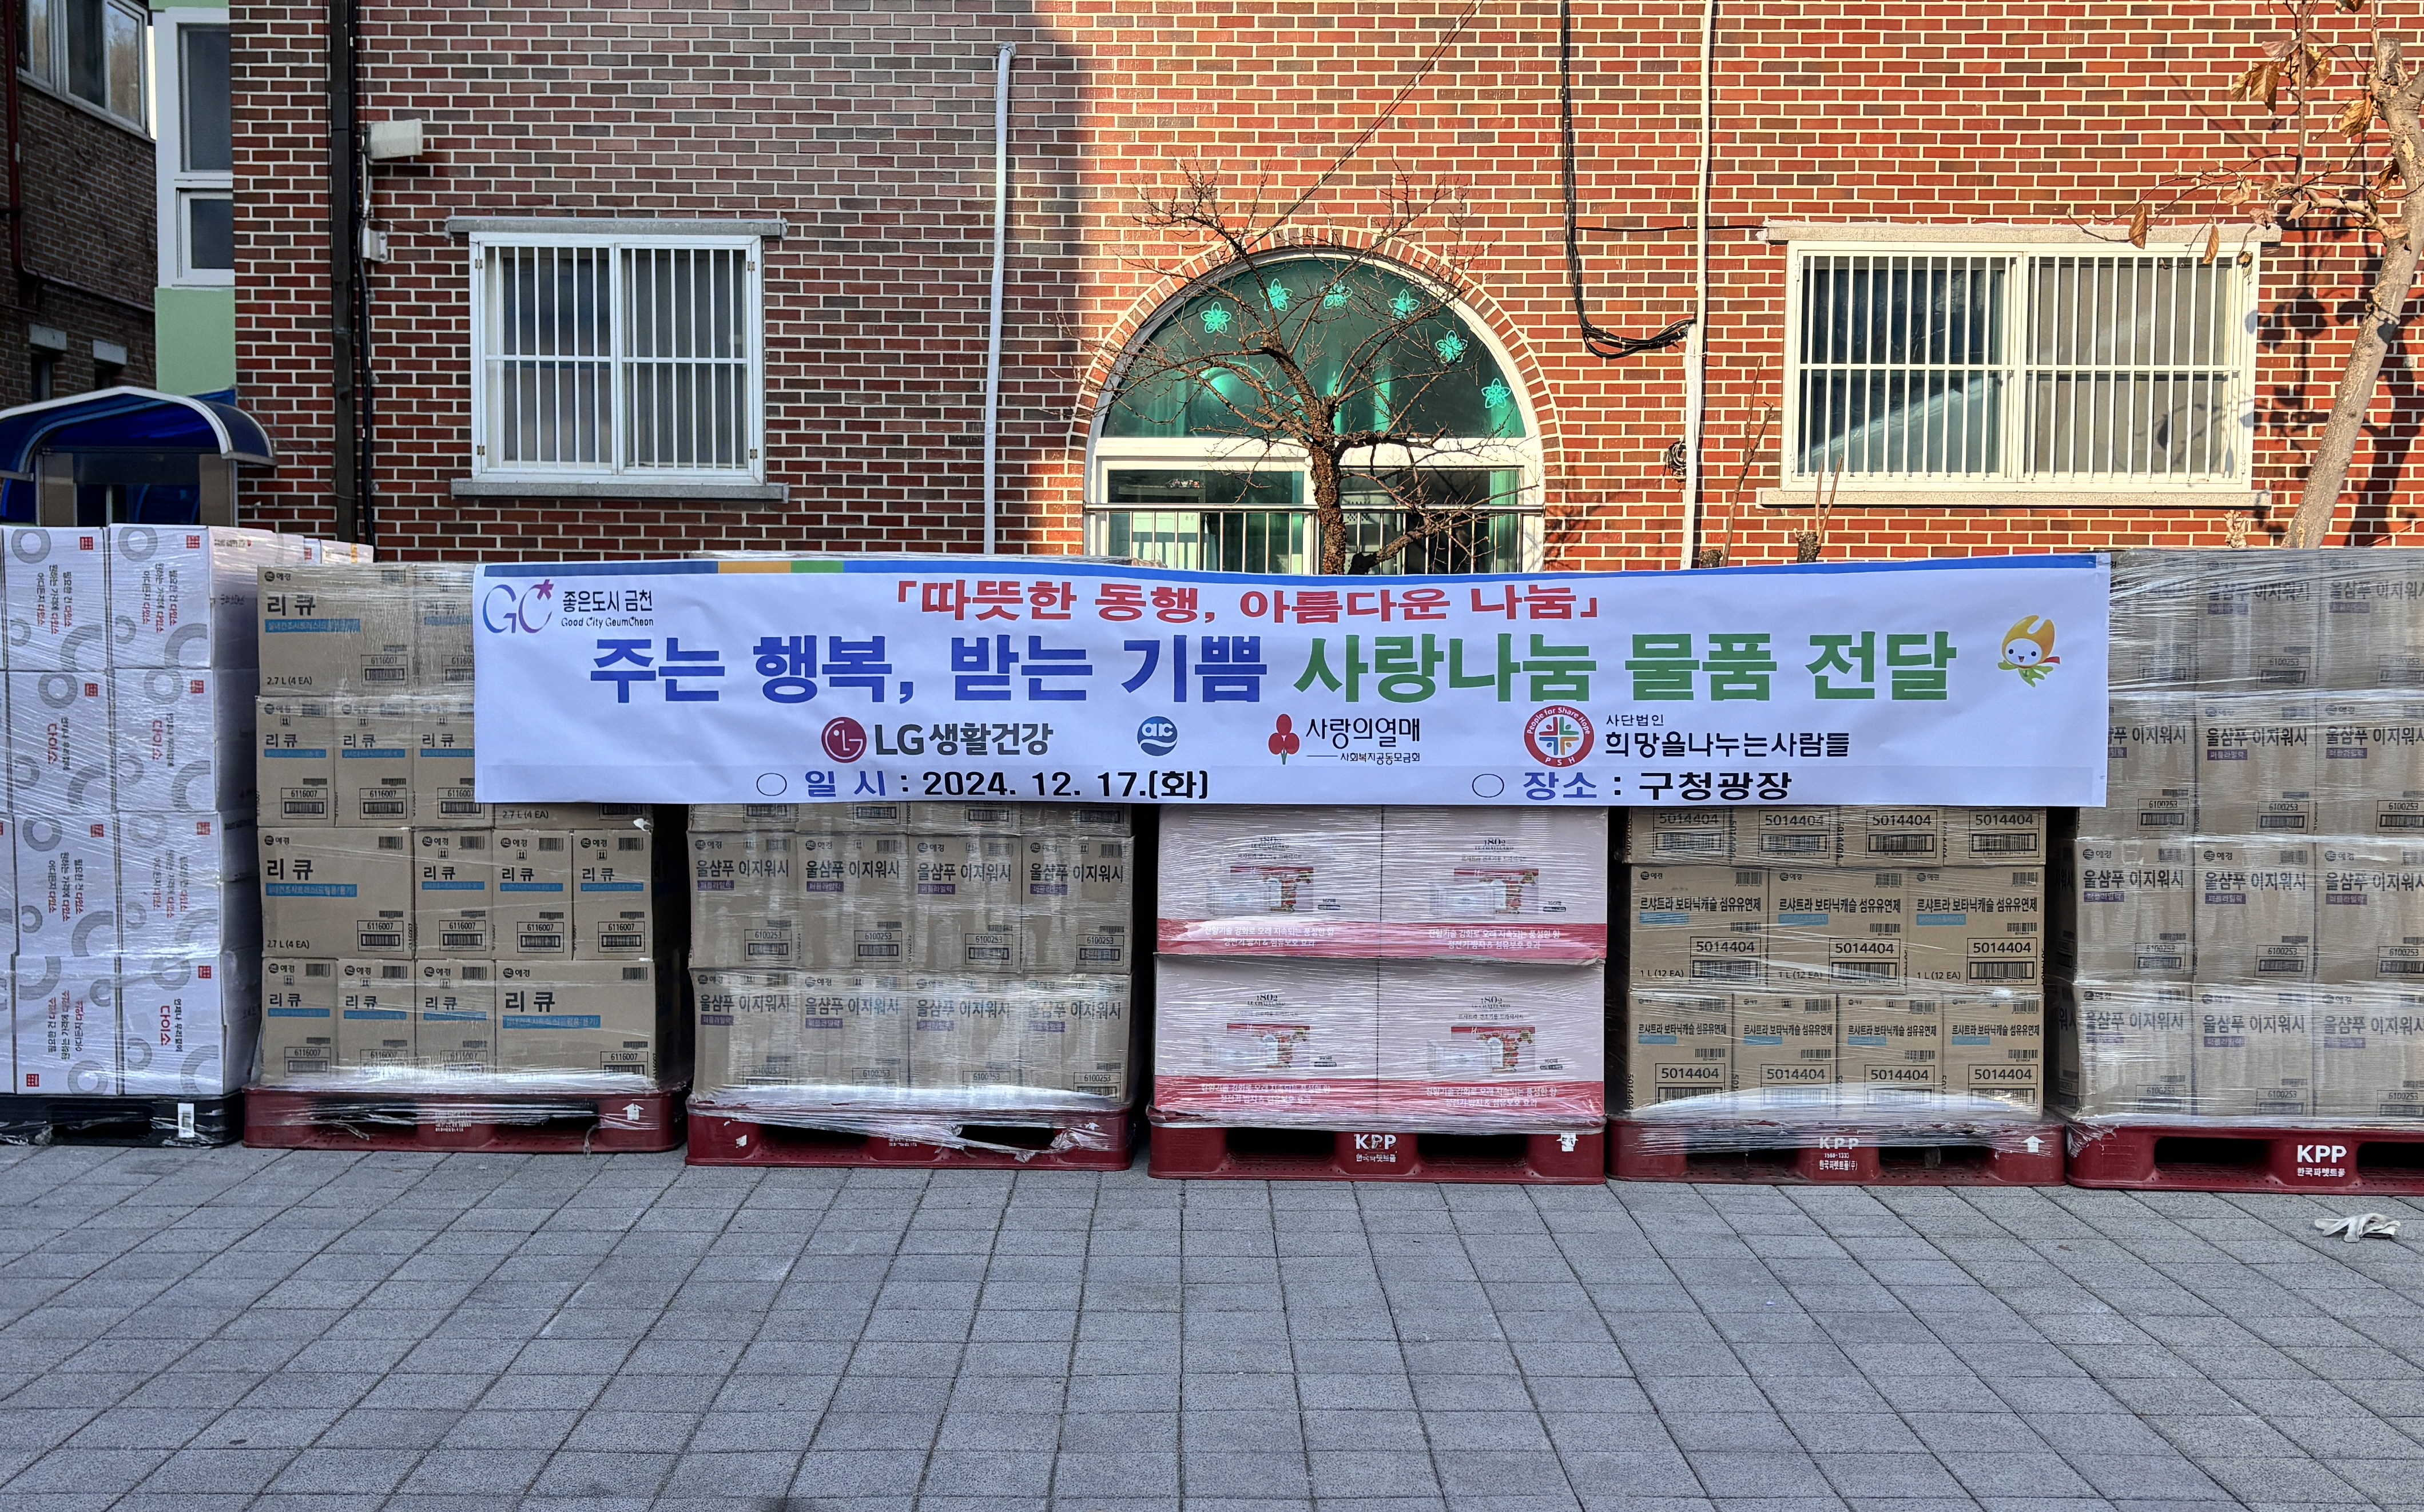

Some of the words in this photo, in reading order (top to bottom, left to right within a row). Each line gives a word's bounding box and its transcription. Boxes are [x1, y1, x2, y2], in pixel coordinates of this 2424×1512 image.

[563, 590, 619, 612] 좋은도시
[625, 590, 652, 612] 금천
[897, 579, 1077, 622] 「따뜻한
[1095, 582, 1215, 623] 동행,
[1240, 588, 1451, 623] 아름다운
[1471, 584, 1598, 619] 나눔」
[562, 617, 583, 627] Good
[586, 617, 603, 628] City
[606, 616, 653, 626] GeumCheon
[590, 637, 725, 703] 주는
[753, 635, 913, 704] 행복,
[951, 634, 1093, 701] 받는
[1122, 635, 1267, 702] 기쁨
[1293, 633, 1596, 703] 사랑나눔
[1624, 632, 1777, 702] 물품
[1805, 630, 1957, 701] 전달
[1527, 711, 1544, 734] People
[1558, 707, 1579, 718] Share
[1579, 714, 1591, 735] Hope
[1606, 714, 1663, 726] 사단법인
[152, 720, 163, 760] 다이소
[1306, 718, 1419, 749] 사랑의열매
[2132, 726, 2185, 744] 이지워시
[47, 723, 57, 764] 다이소
[1606, 731, 1850, 758] 희망을나누는사람들
[1340, 753, 1420, 765] 사회복지공동모금회
[924, 771, 1015, 796] 2024.
[1034, 771, 1080, 796] 12.
[1523, 772, 1596, 801] 장소
[1639, 771, 1791, 800] 구청광장
[696, 860, 734, 878] 울샴푸
[739, 860, 788, 877] 이지워시
[806, 861, 844, 878] 울샴푸
[849, 860, 899, 878] 이지워시
[917, 864, 956, 881] 울샴푸
[961, 864, 1011, 881] 이지워시
[2083, 870, 2125, 889] 울샴푸
[2130, 870, 2183, 888] 이지워시
[2205, 872, 2246, 890] 울샴푸
[2251, 872, 2306, 890] 이지워시
[62, 900, 70, 921] 다있소
[75, 893, 84, 914] 다있소
[1720, 897, 1761, 912] 섬유유연제
[1779, 898, 1813, 912] 르샤트라
[1815, 898, 1857, 913] 보타닉캐슬
[1859, 898, 1901, 913] 섬유유연제
[1917, 898, 1950, 912] 르샤트라
[1953, 898, 1993, 912] 보타닉캐슬
[1997, 898, 2037, 912] 섬유유연제
[367, 922, 393, 930] 6116007
[1696, 942, 1754, 952] 5014404
[1835, 943, 1894, 953] 5014404
[1973, 943, 2031, 953] 5014404
[700, 995, 734, 1013] 울샴푸
[739, 995, 789, 1012] 이지워시
[805, 997, 843, 1015] 울샴푸
[848, 997, 899, 1015] 이지워시
[1071, 1002, 1120, 1019] 이지워시
[49, 1020, 56, 1028] 건
[160, 1005, 170, 1046] 다이소
[2250, 1015, 2304, 1033] 이지워시
[1662, 1069, 1719, 1079] 5014404
[1767, 1069, 1825, 1079] 5014404
[1871, 1069, 1929, 1080] 5014404
[1974, 1069, 2032, 1079] 5014404
[1354, 1134, 1396, 1149] KPP
[1819, 1137, 1859, 1149] KPP
[2297, 1145, 2347, 1163] KPP
